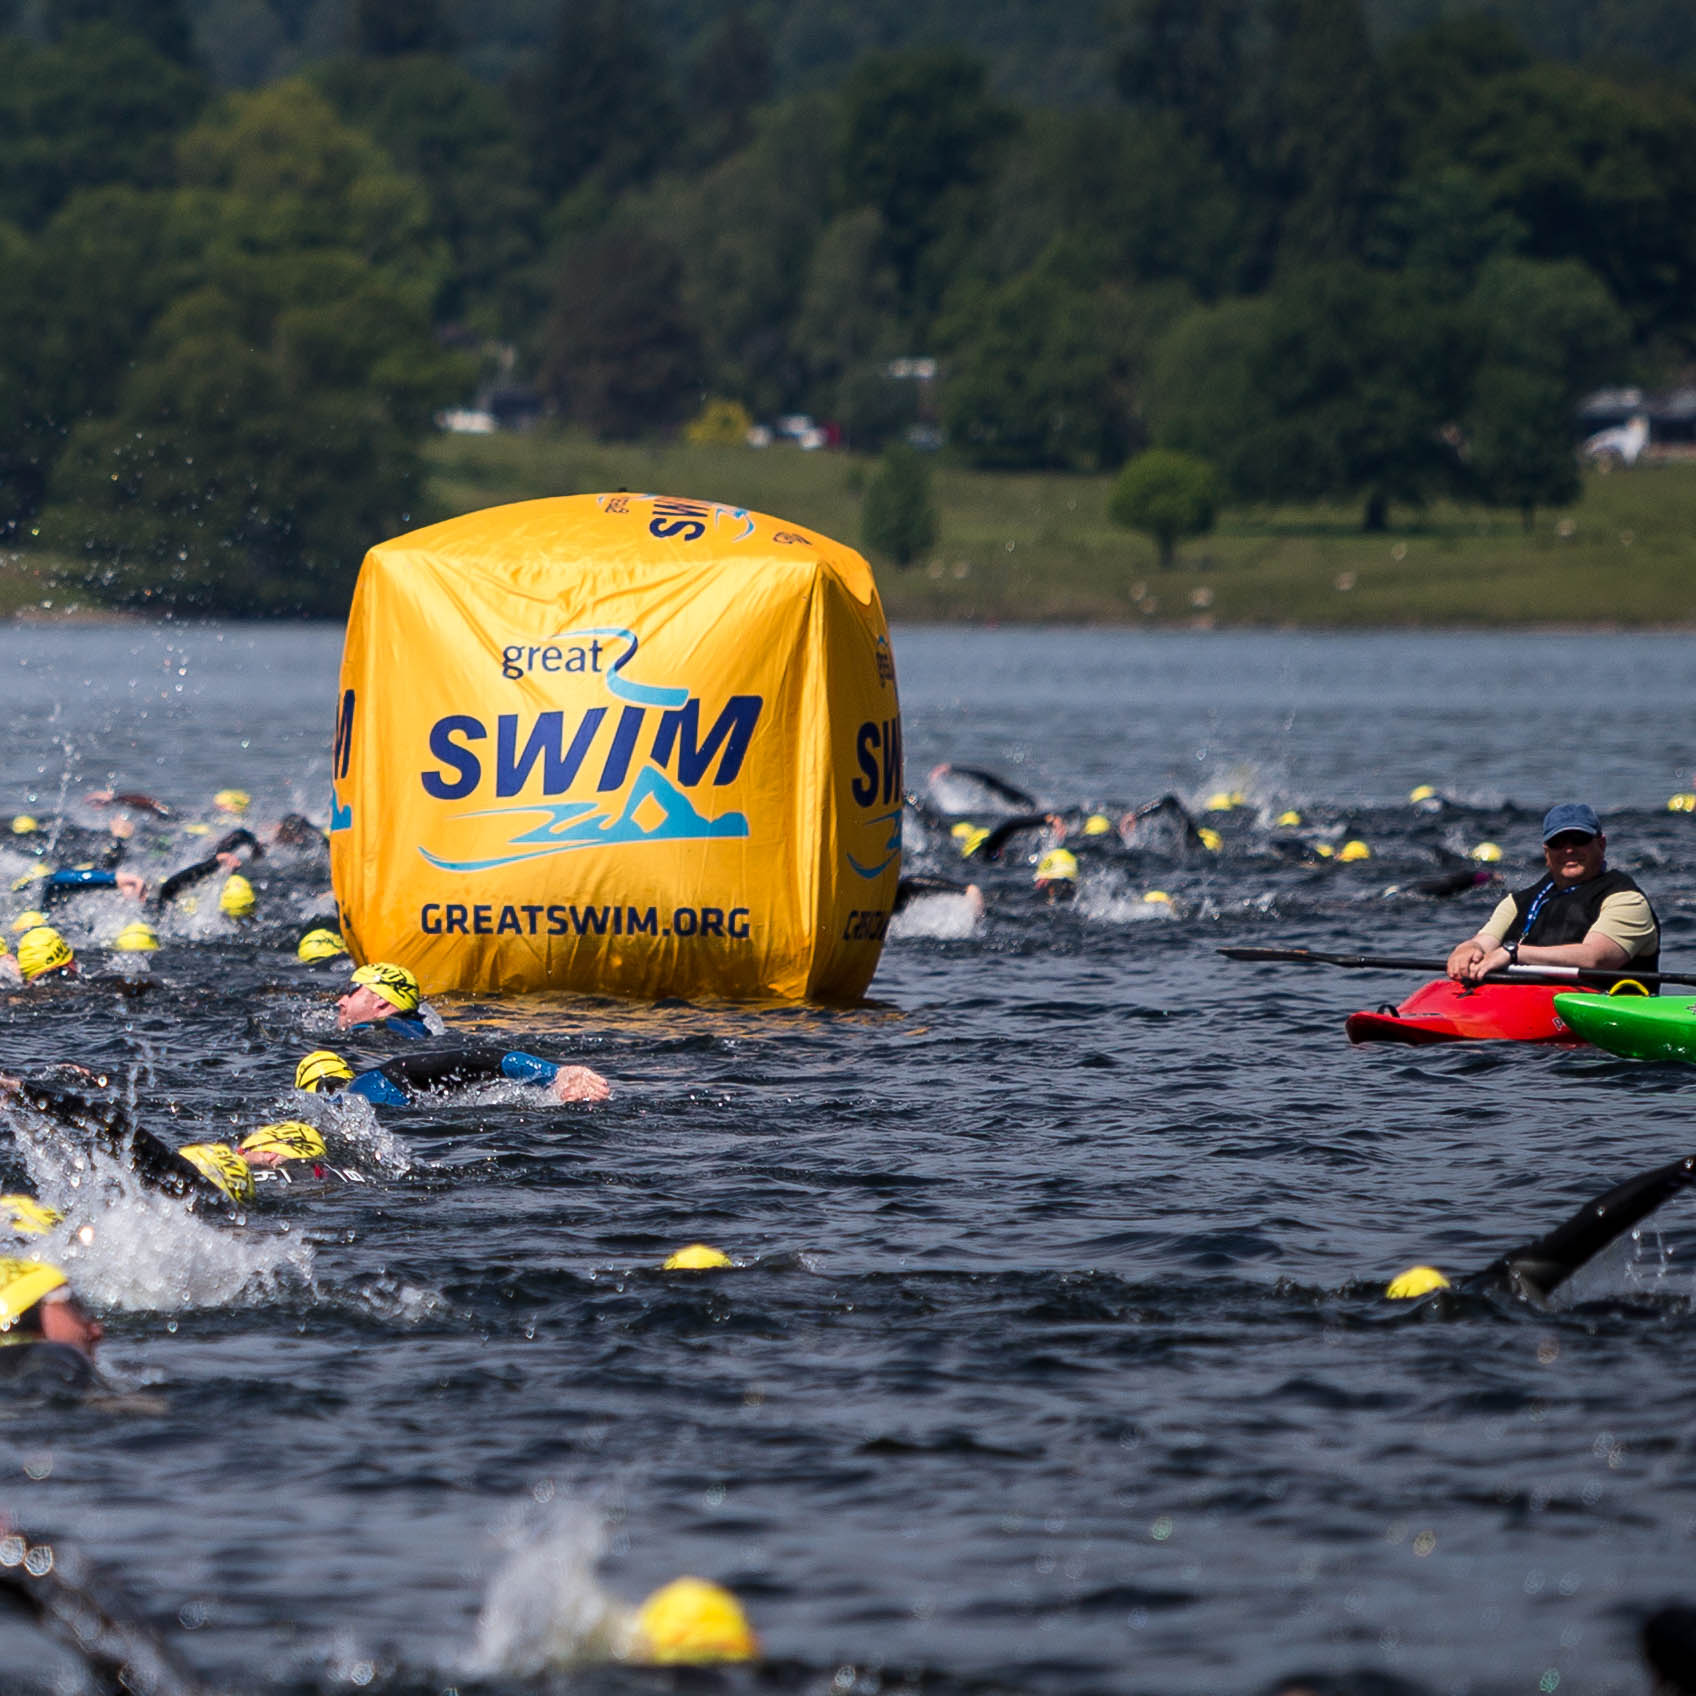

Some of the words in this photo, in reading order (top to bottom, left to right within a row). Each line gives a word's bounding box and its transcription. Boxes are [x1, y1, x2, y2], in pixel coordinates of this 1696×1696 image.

[502, 639, 603, 680] great
[421, 695, 764, 801] SWIM
[420, 903, 751, 939] GREATSWIM.ORG
